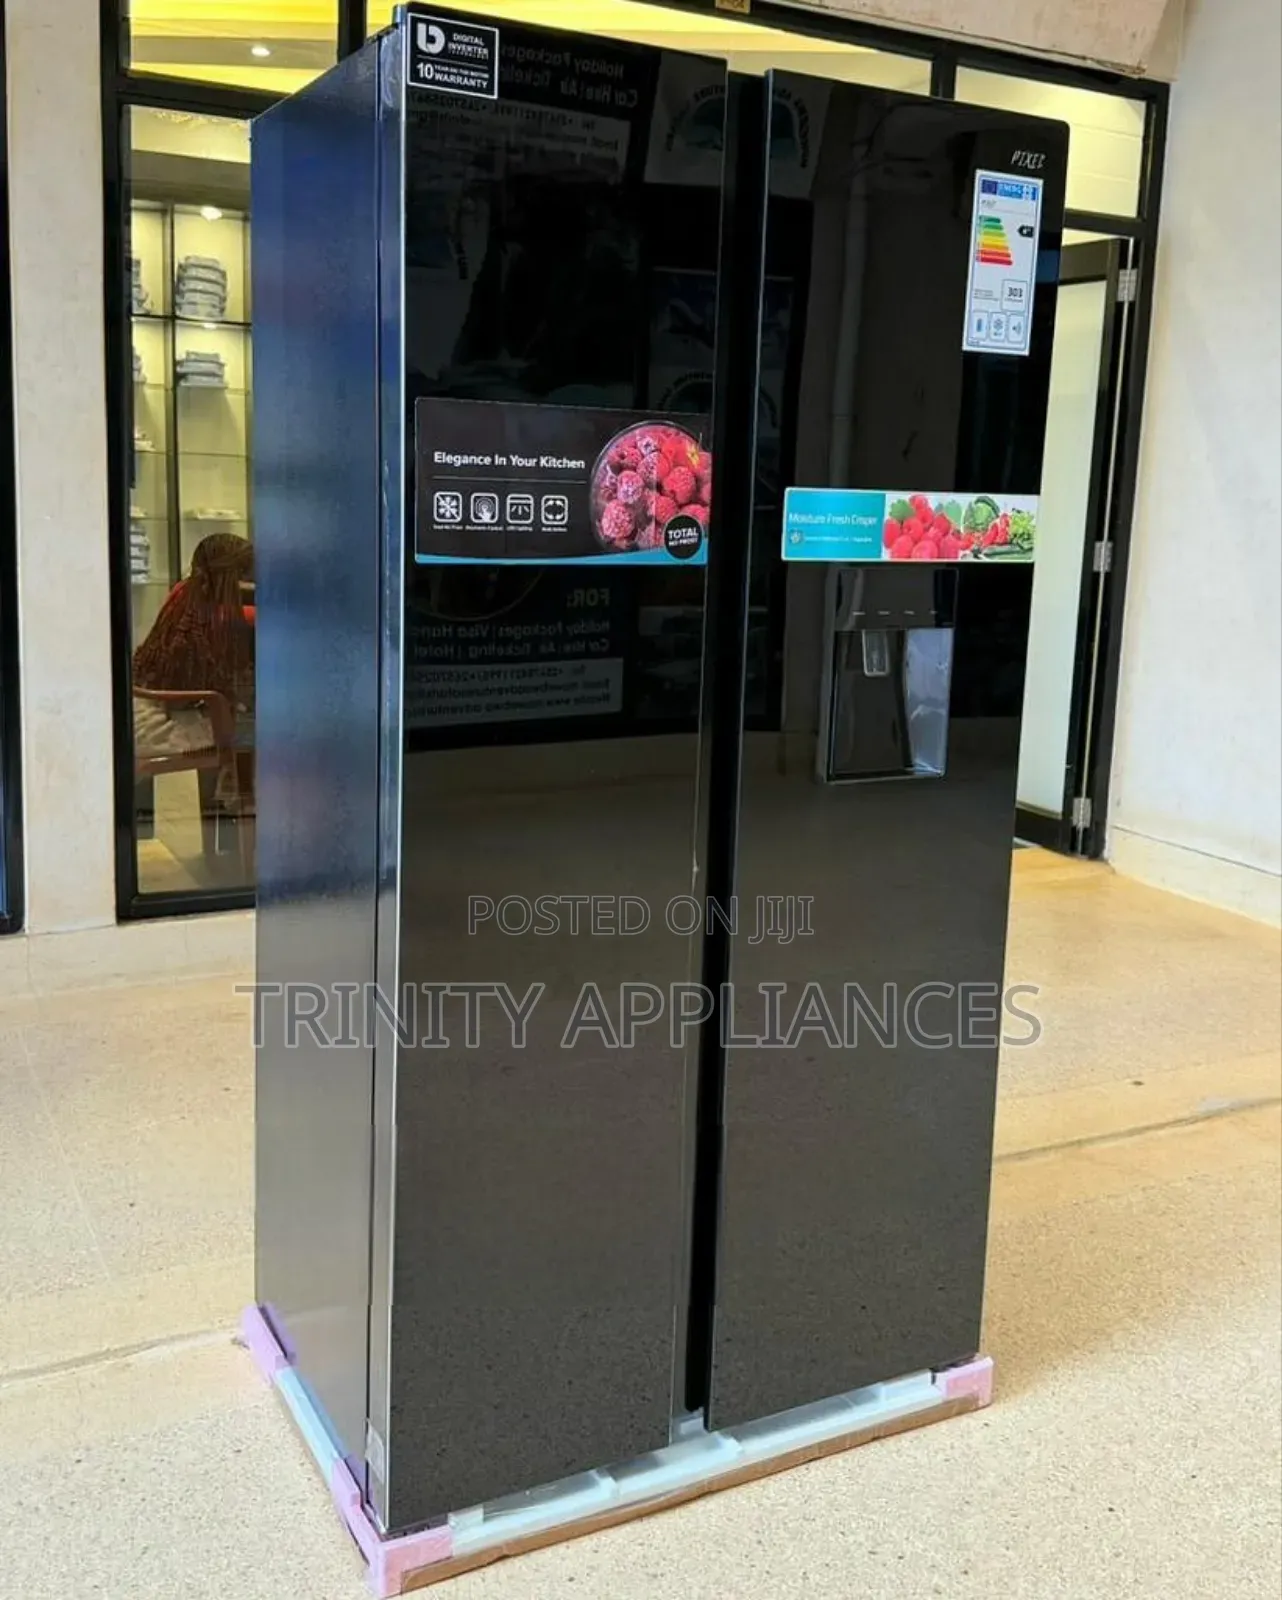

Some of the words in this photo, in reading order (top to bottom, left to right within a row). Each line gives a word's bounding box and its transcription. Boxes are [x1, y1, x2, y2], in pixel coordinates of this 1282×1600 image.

[453, 32, 485, 46] DIGITAL
[447, 42, 489, 54] INVERTER
[416, 61, 434, 79] 10
[434, 72, 489, 89] WARRANTY
[1008, 286, 1023, 298] 303
[433, 451, 492, 467] Elegance
[494, 453, 507, 466] In
[509, 454, 538, 467] Your
[539, 456, 586, 469] Kitchen
[826, 512, 851, 525] Fresh
[668, 527, 699, 540] TOTAL
